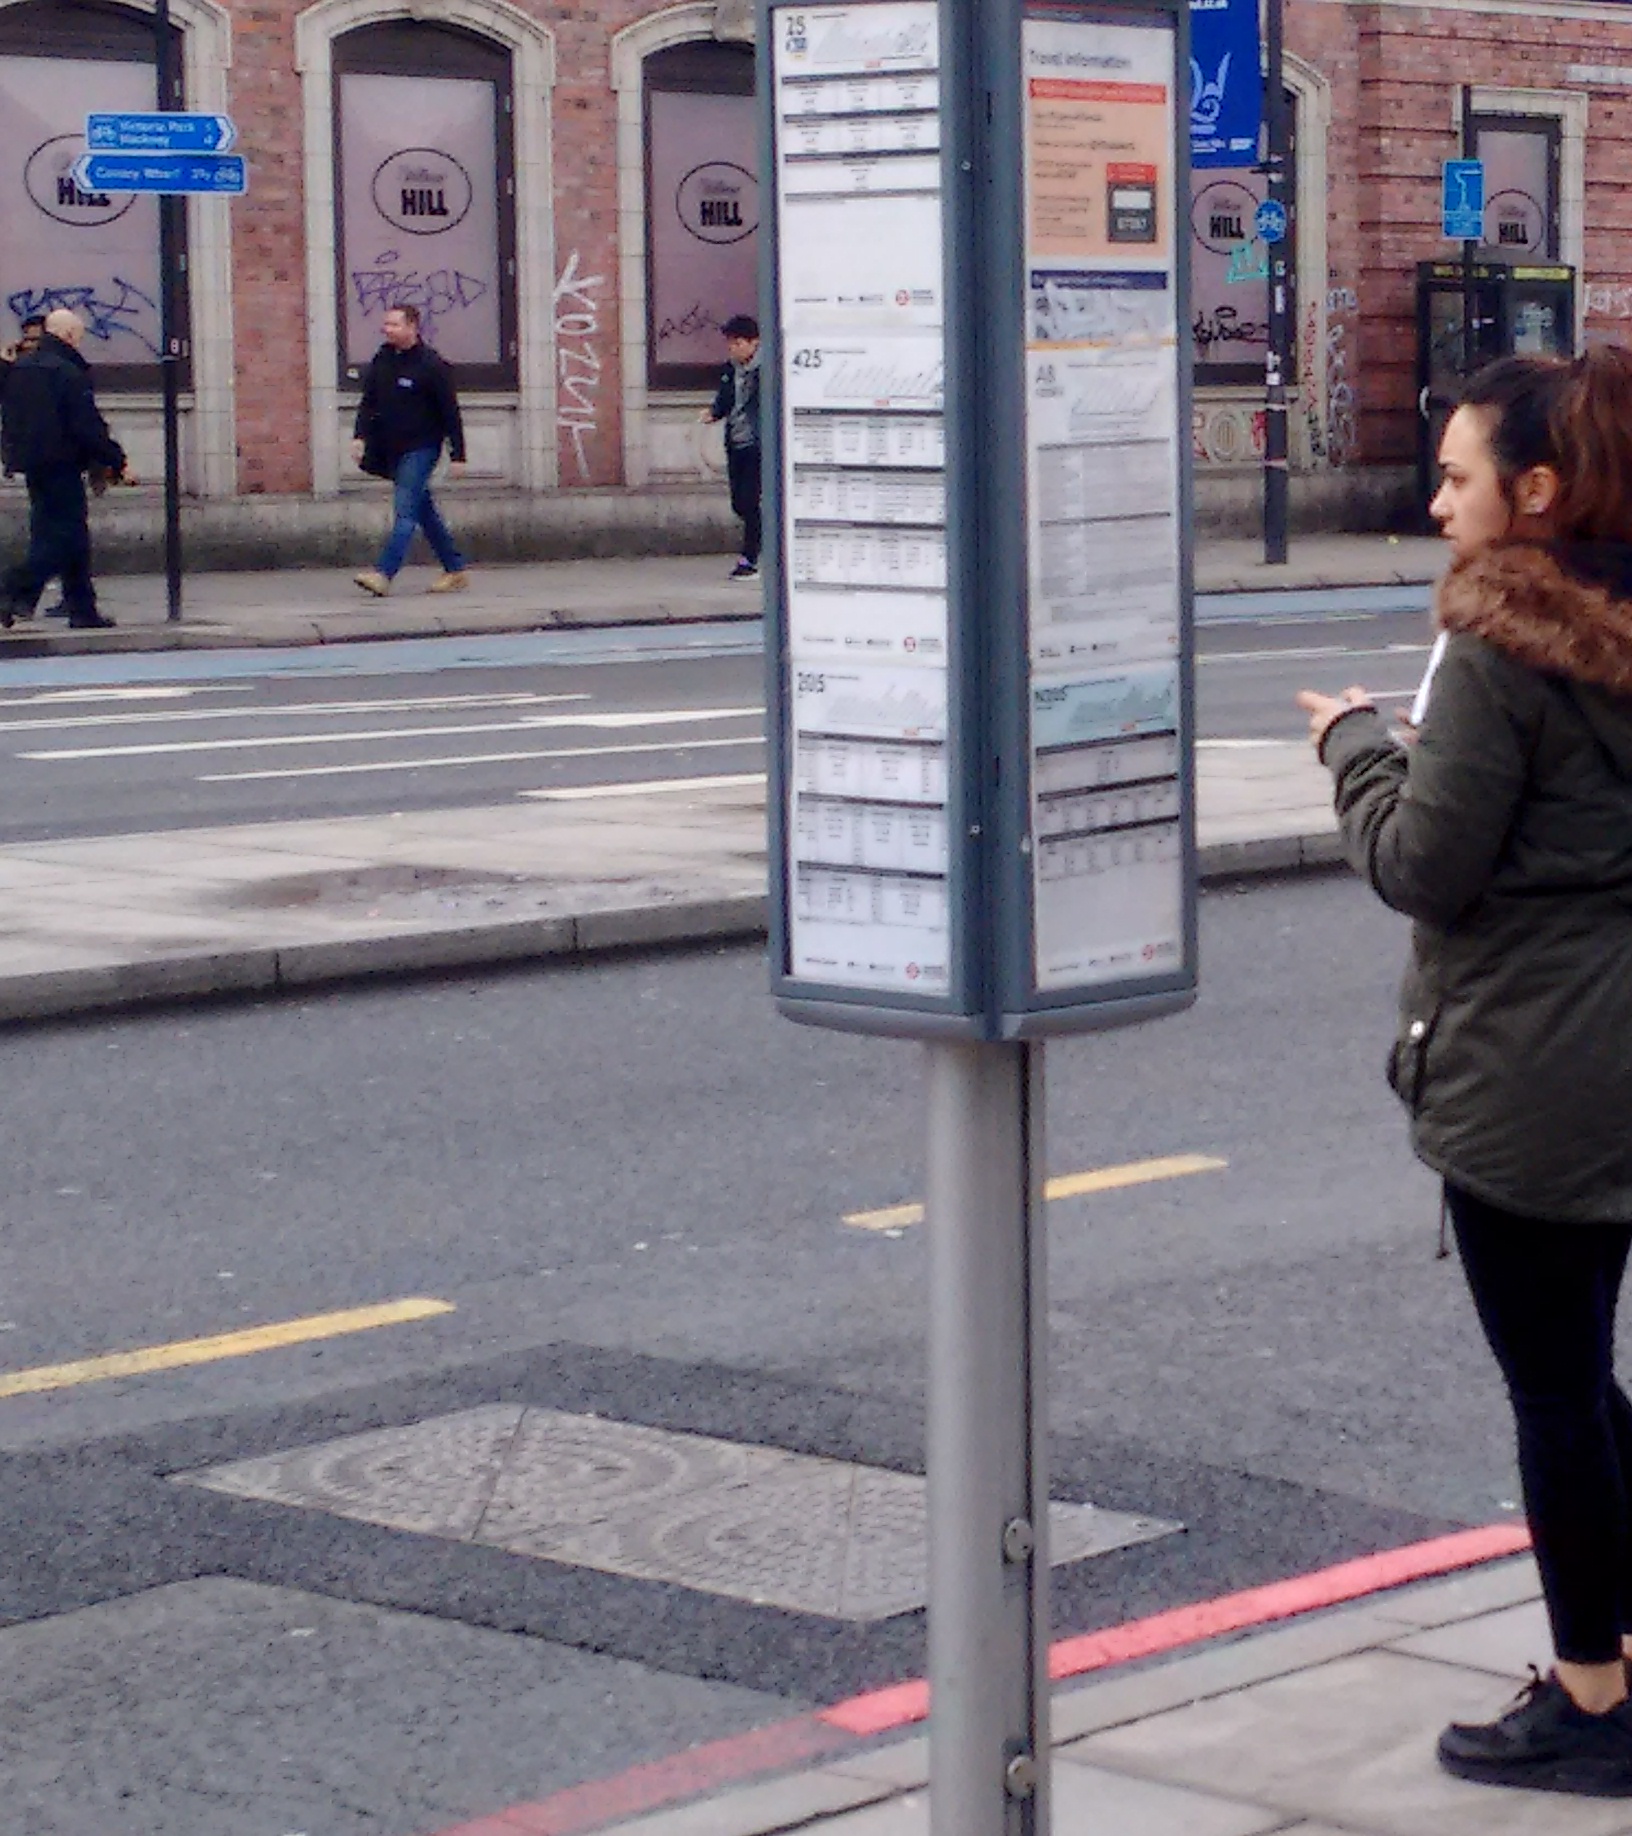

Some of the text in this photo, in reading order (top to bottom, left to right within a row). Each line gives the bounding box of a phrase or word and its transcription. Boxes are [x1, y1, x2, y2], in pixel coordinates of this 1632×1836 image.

[402, 189, 448, 216] HILL
[701, 201, 742, 226] HILL
[1210, 215, 1245, 239] HILL
[1499, 222, 1528, 244] HILL
[793, 349, 822, 368] 425
